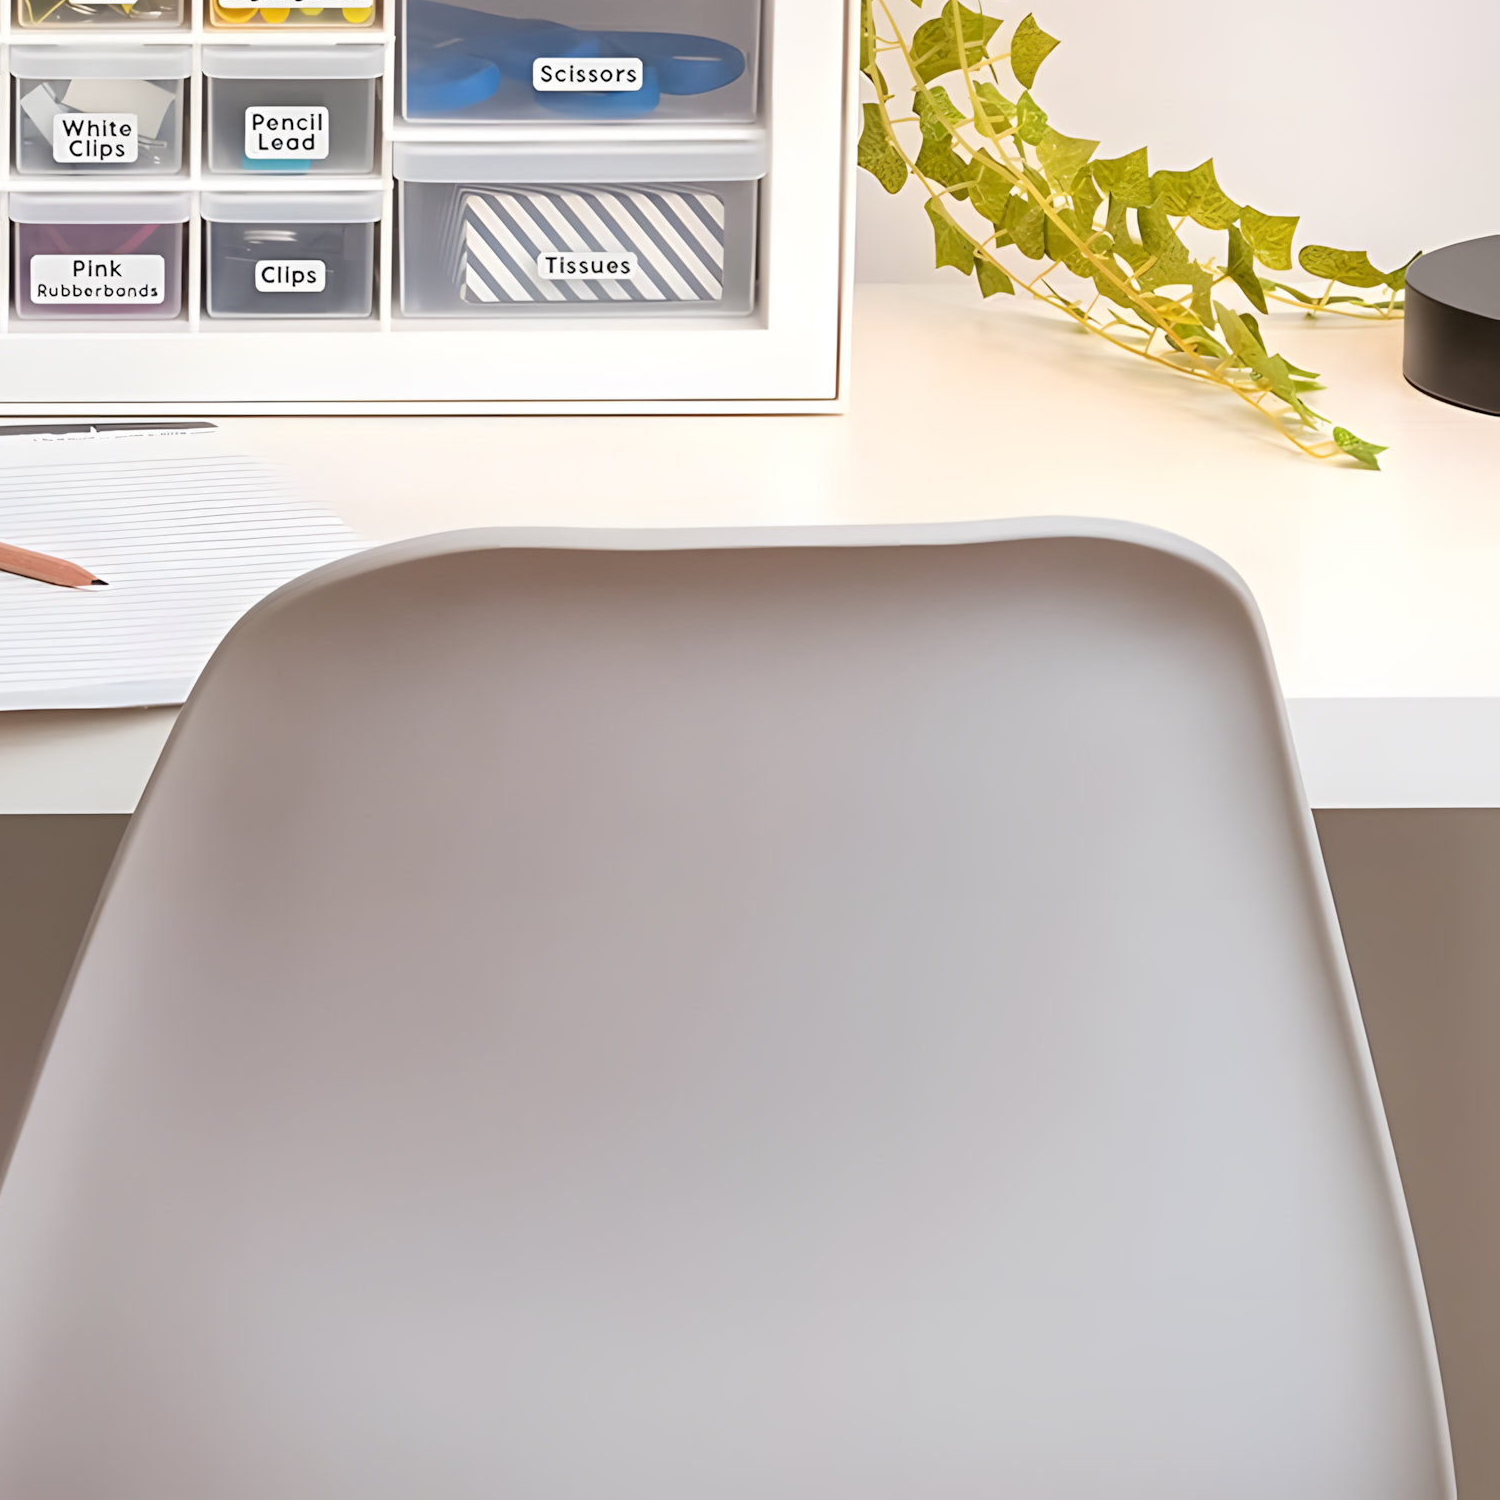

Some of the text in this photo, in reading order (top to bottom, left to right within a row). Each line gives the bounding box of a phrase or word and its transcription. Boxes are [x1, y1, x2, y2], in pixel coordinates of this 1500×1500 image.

[540, 64, 637, 83] Scissors
[62, 119, 132, 137] White
[252, 113, 322, 131] Pencil
[69, 139, 125, 161] Clips
[258, 133, 315, 151] Lead
[73, 259, 122, 277] Pink
[545, 256, 631, 275] Tissues
[261, 266, 317, 288] Clips
[37, 283, 158, 298] Rubberbands
